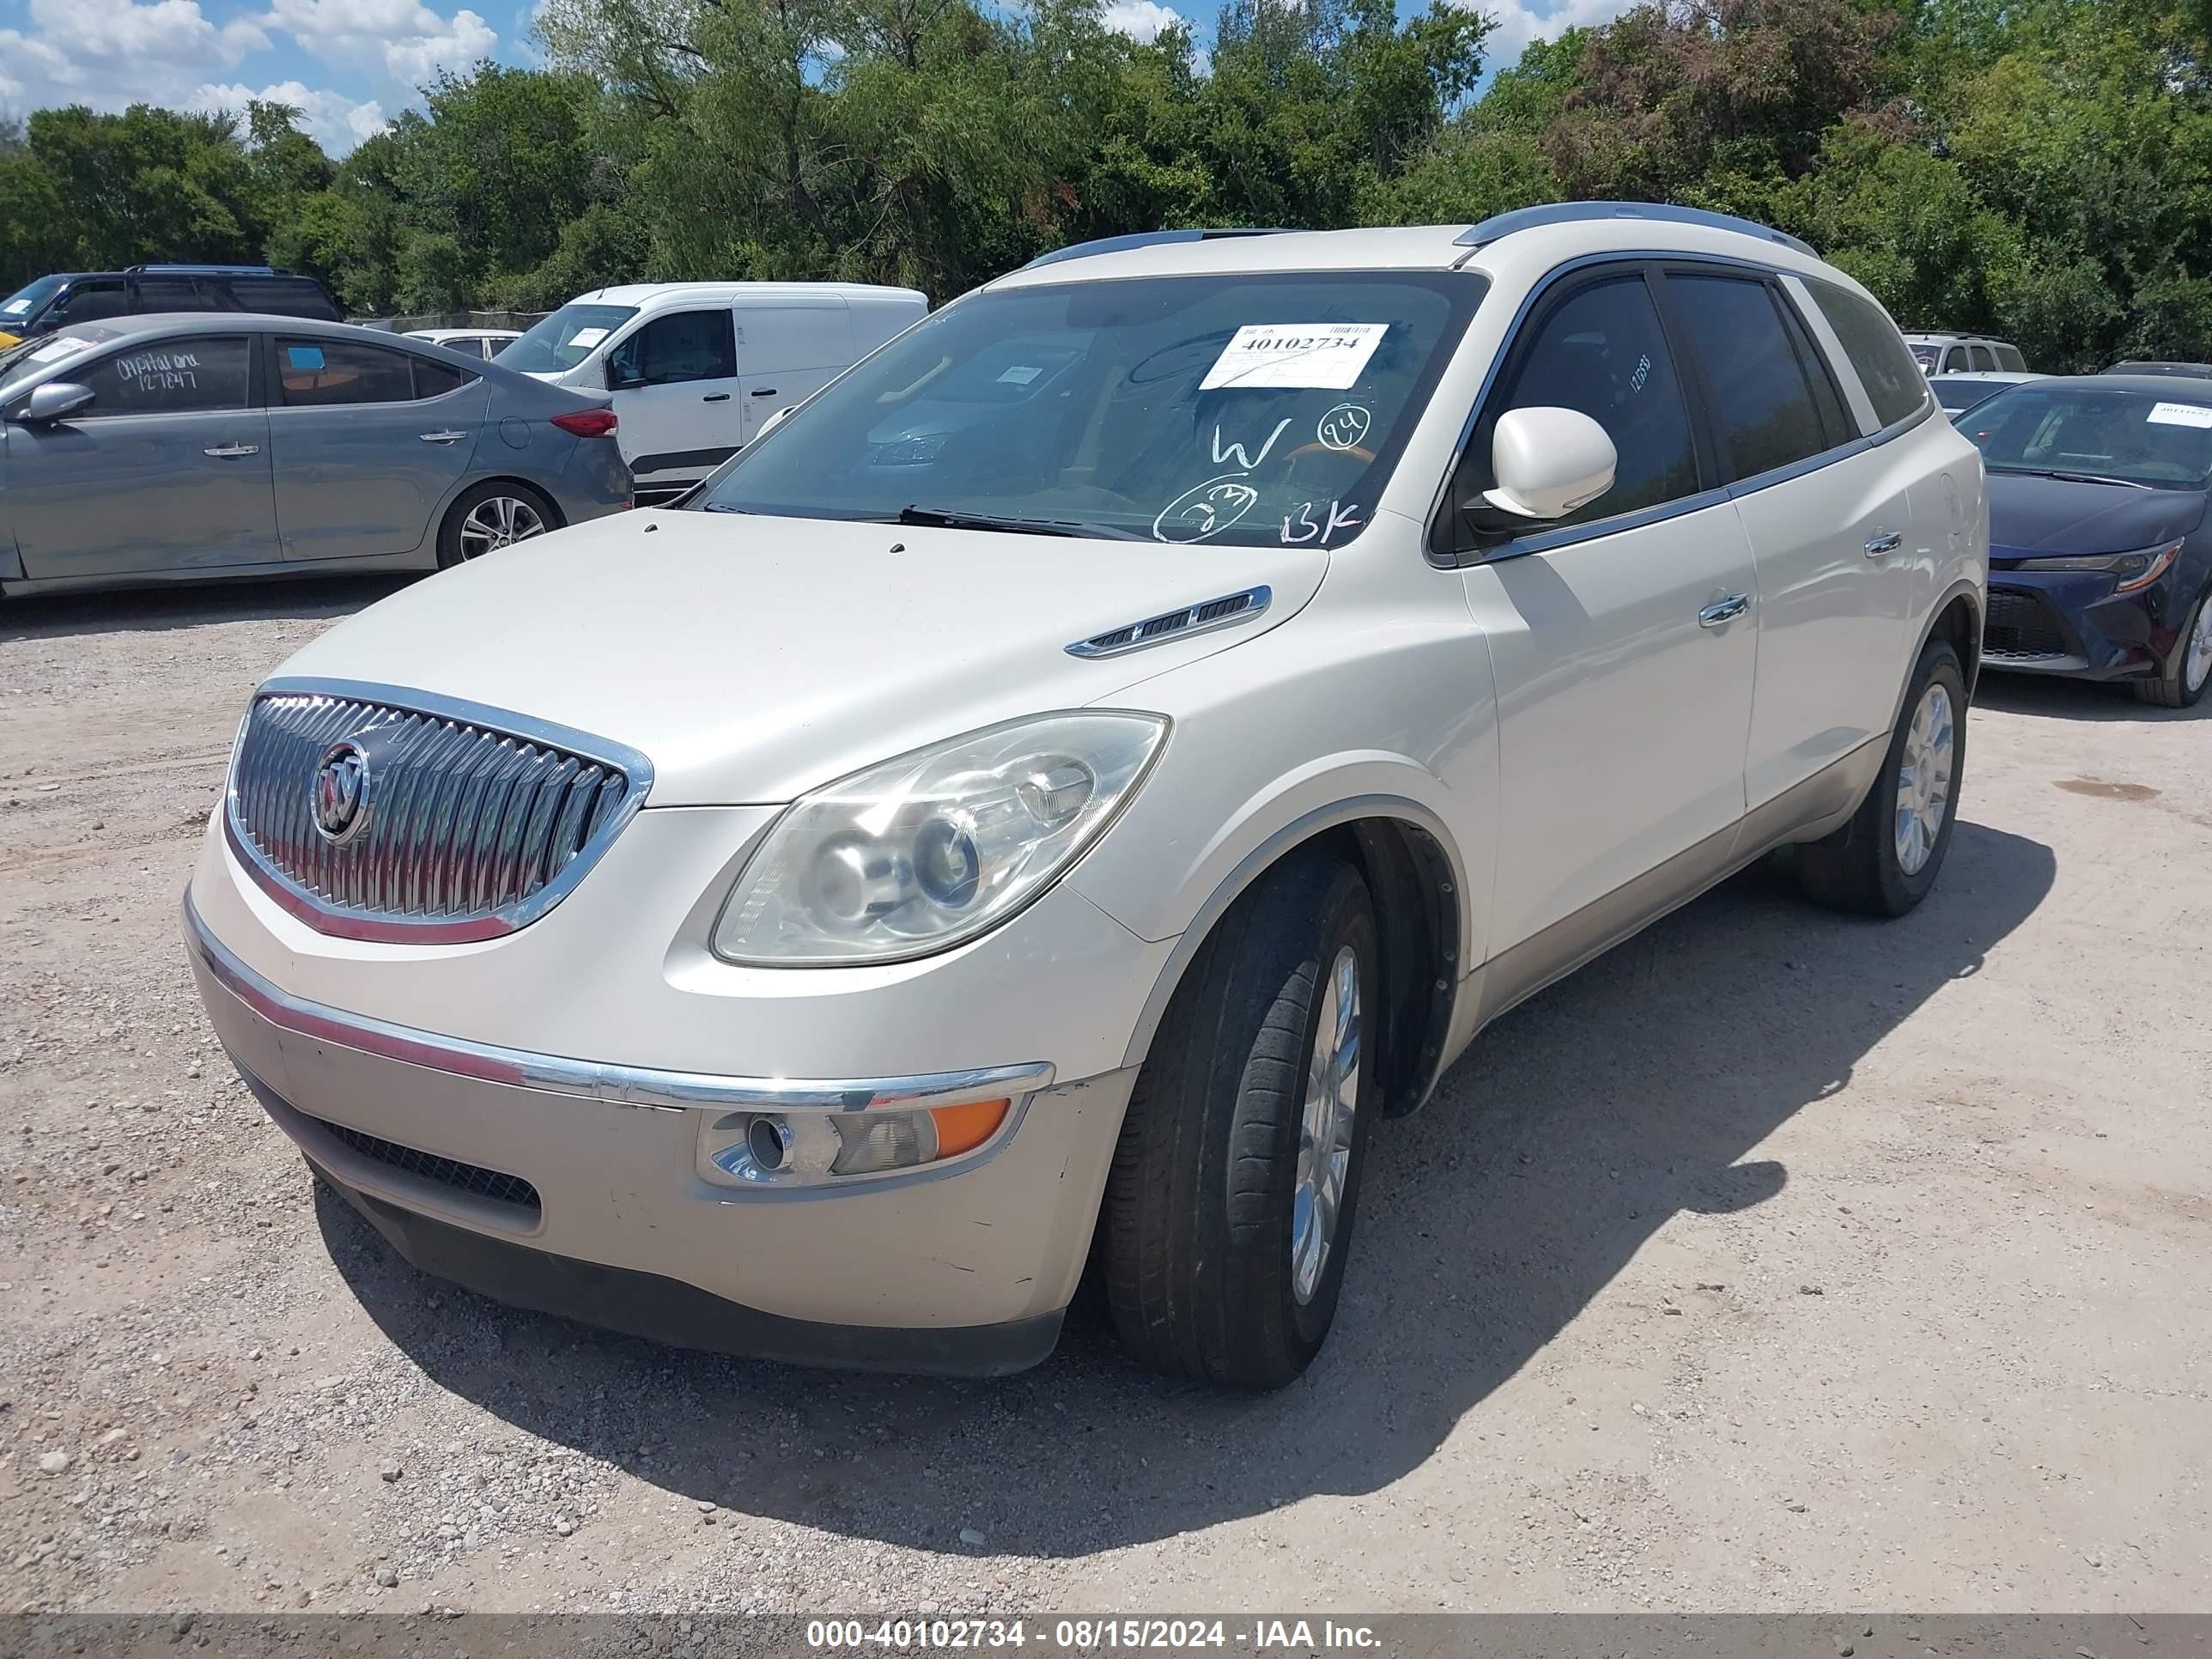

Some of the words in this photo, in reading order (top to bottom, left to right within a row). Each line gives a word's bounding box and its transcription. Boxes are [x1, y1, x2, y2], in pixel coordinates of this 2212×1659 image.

[1242, 337, 1360, 350] 40102734
[1212, 418, 1293, 469] W
[1324, 411, 1364, 446] 24
[1279, 500, 1362, 544] BK
